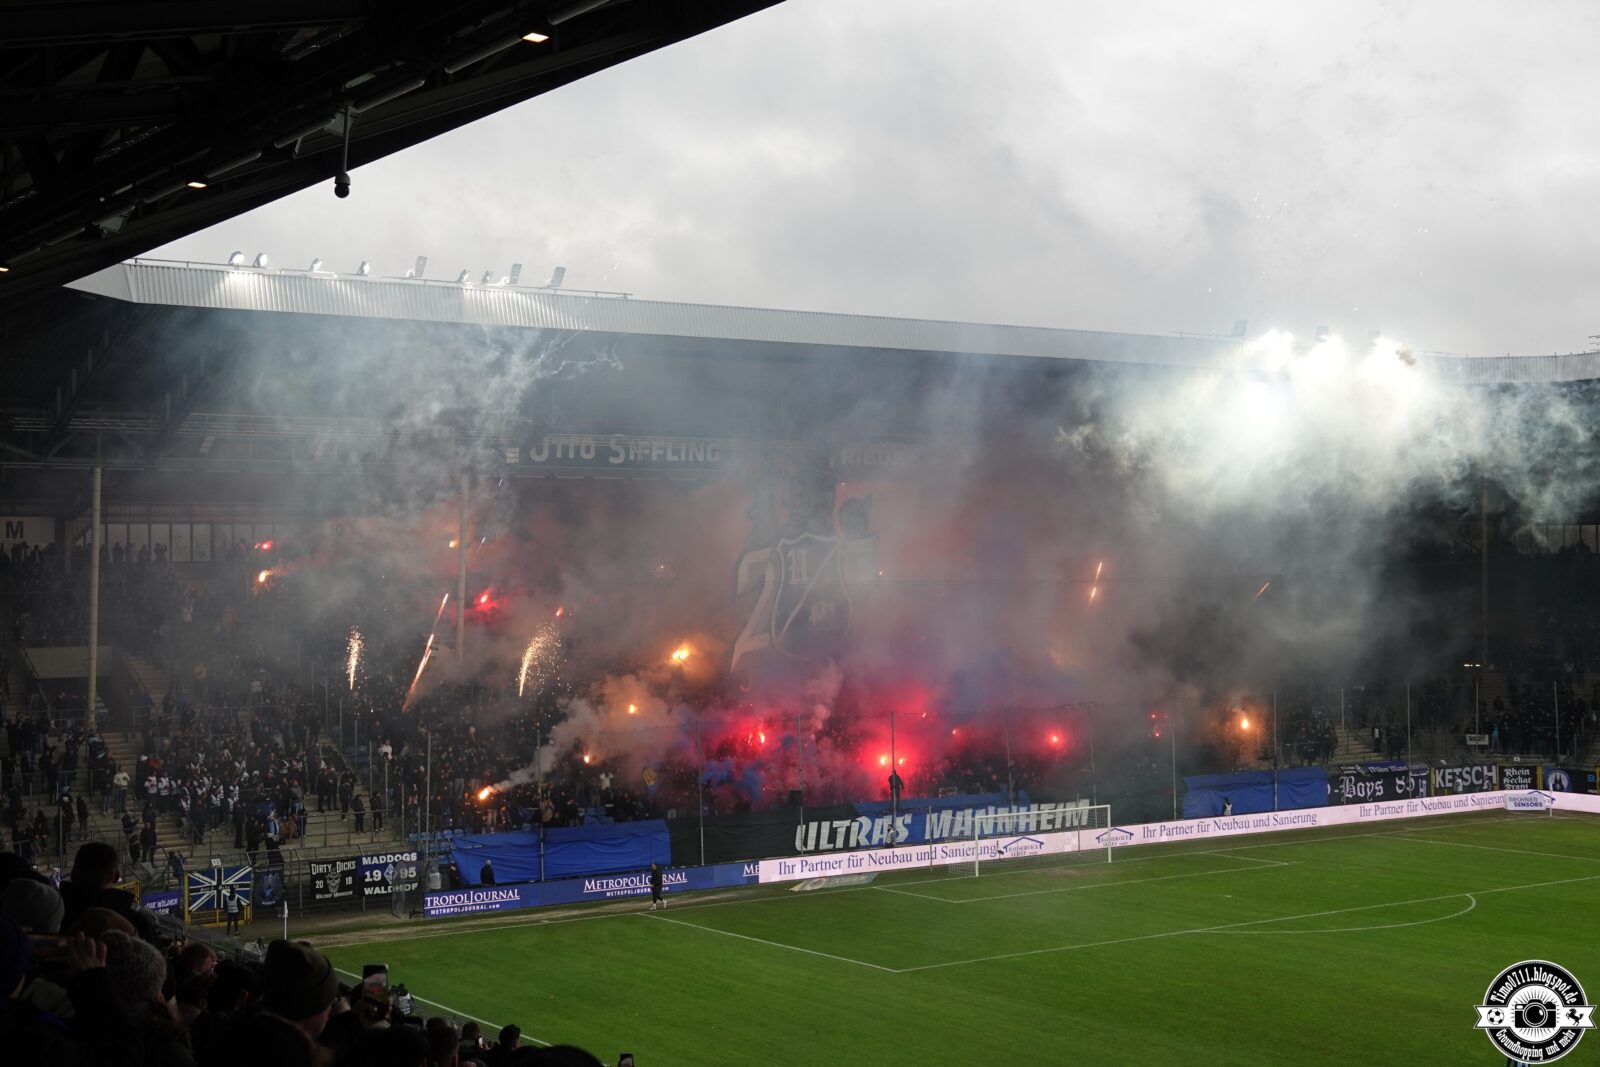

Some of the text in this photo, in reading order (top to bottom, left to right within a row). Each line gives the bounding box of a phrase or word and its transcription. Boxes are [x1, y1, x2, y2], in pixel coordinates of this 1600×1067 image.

[6, 521, 24, 538] M
[1435, 765, 1497, 789] KETSCH
[1359, 794, 1505, 818] Ihr Partner für Neubau und Sanierun
[794, 798, 1090, 852] ULTRAS MANNHEIM
[1142, 812, 1318, 839] Ihr Partner für Neubau und Sanierung
[311, 860, 357, 875] DIRTY DICKS
[362, 852, 418, 865] MADDOGS
[778, 859, 797, 876] Ihr
[800, 857, 844, 873] Partner
[847, 853, 865, 868] für
[868, 850, 913, 867] Neubau
[916, 846, 937, 862] und
[364, 866, 417, 883] 19 95
[583, 872, 688, 891] METROPOLJORNAL
[315, 880, 324, 889] 20
[363, 882, 419, 896] WALDHOF
[424, 888, 520, 907] TROPOLJOURNAL
